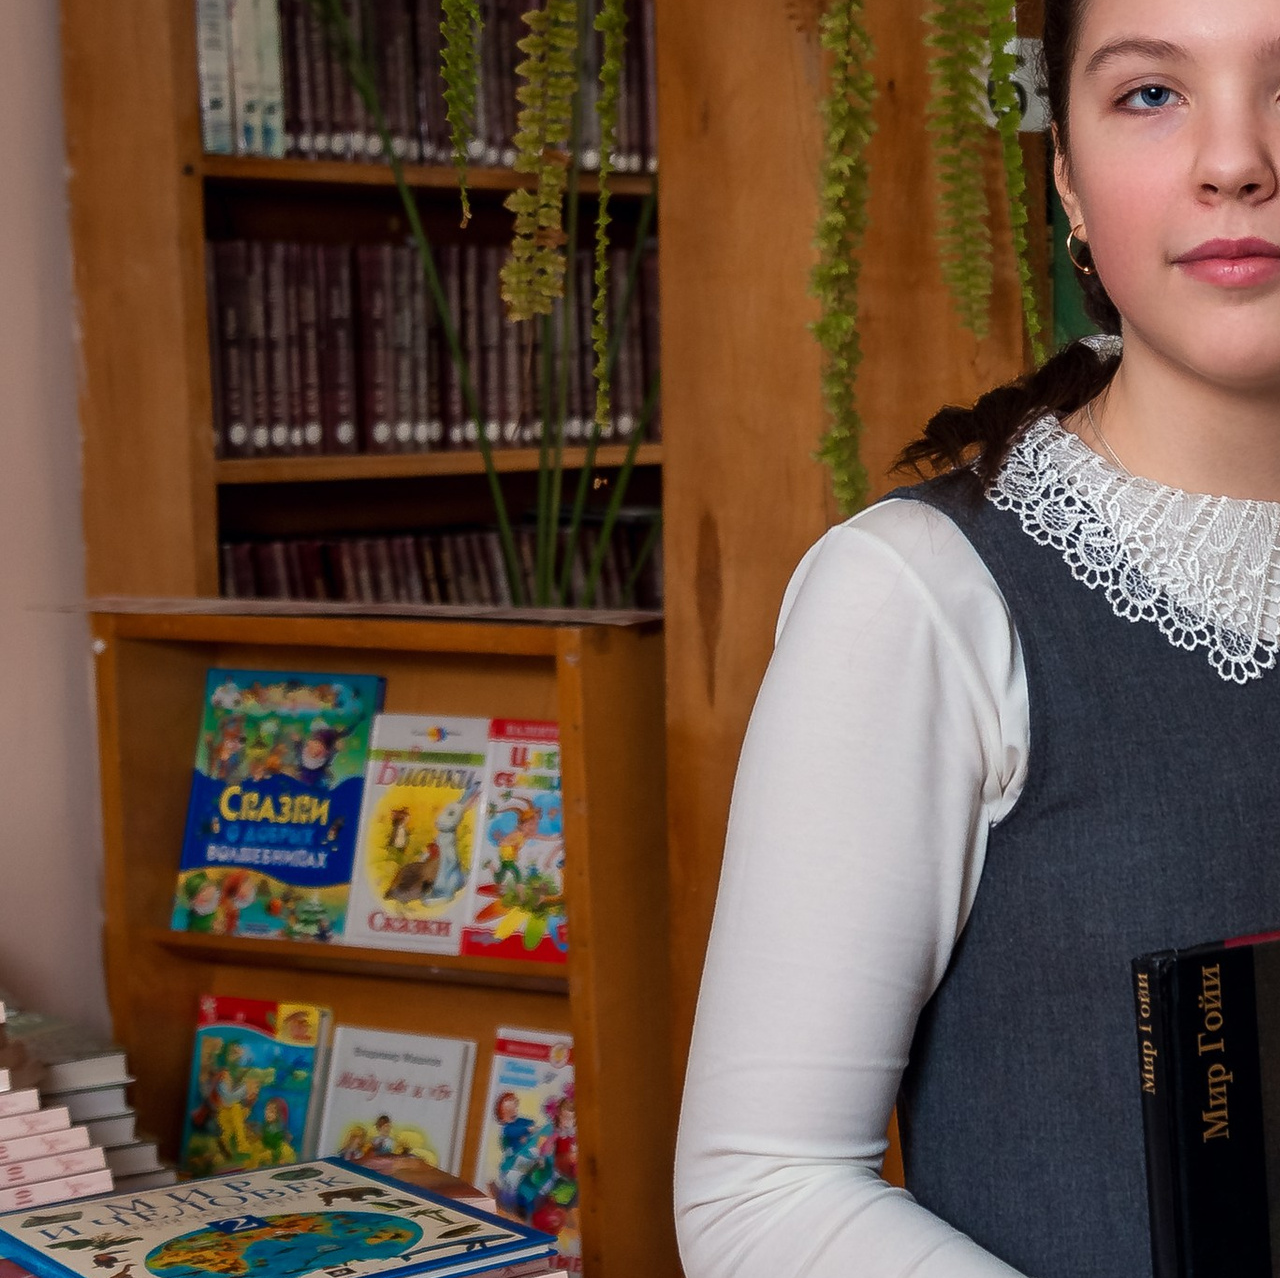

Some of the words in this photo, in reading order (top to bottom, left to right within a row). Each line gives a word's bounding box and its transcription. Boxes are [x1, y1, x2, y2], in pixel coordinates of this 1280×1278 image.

[1197, 964, 1227, 1055] Гойи
[1141, 1039, 1157, 1095] Мир
[1203, 1065, 1234, 1144] Мир
[38, 1225, 82, 1241] И
[91, 1175, 356, 1227] ЧЕЛОВЕК
[104, 1179, 253, 1216] МИР
